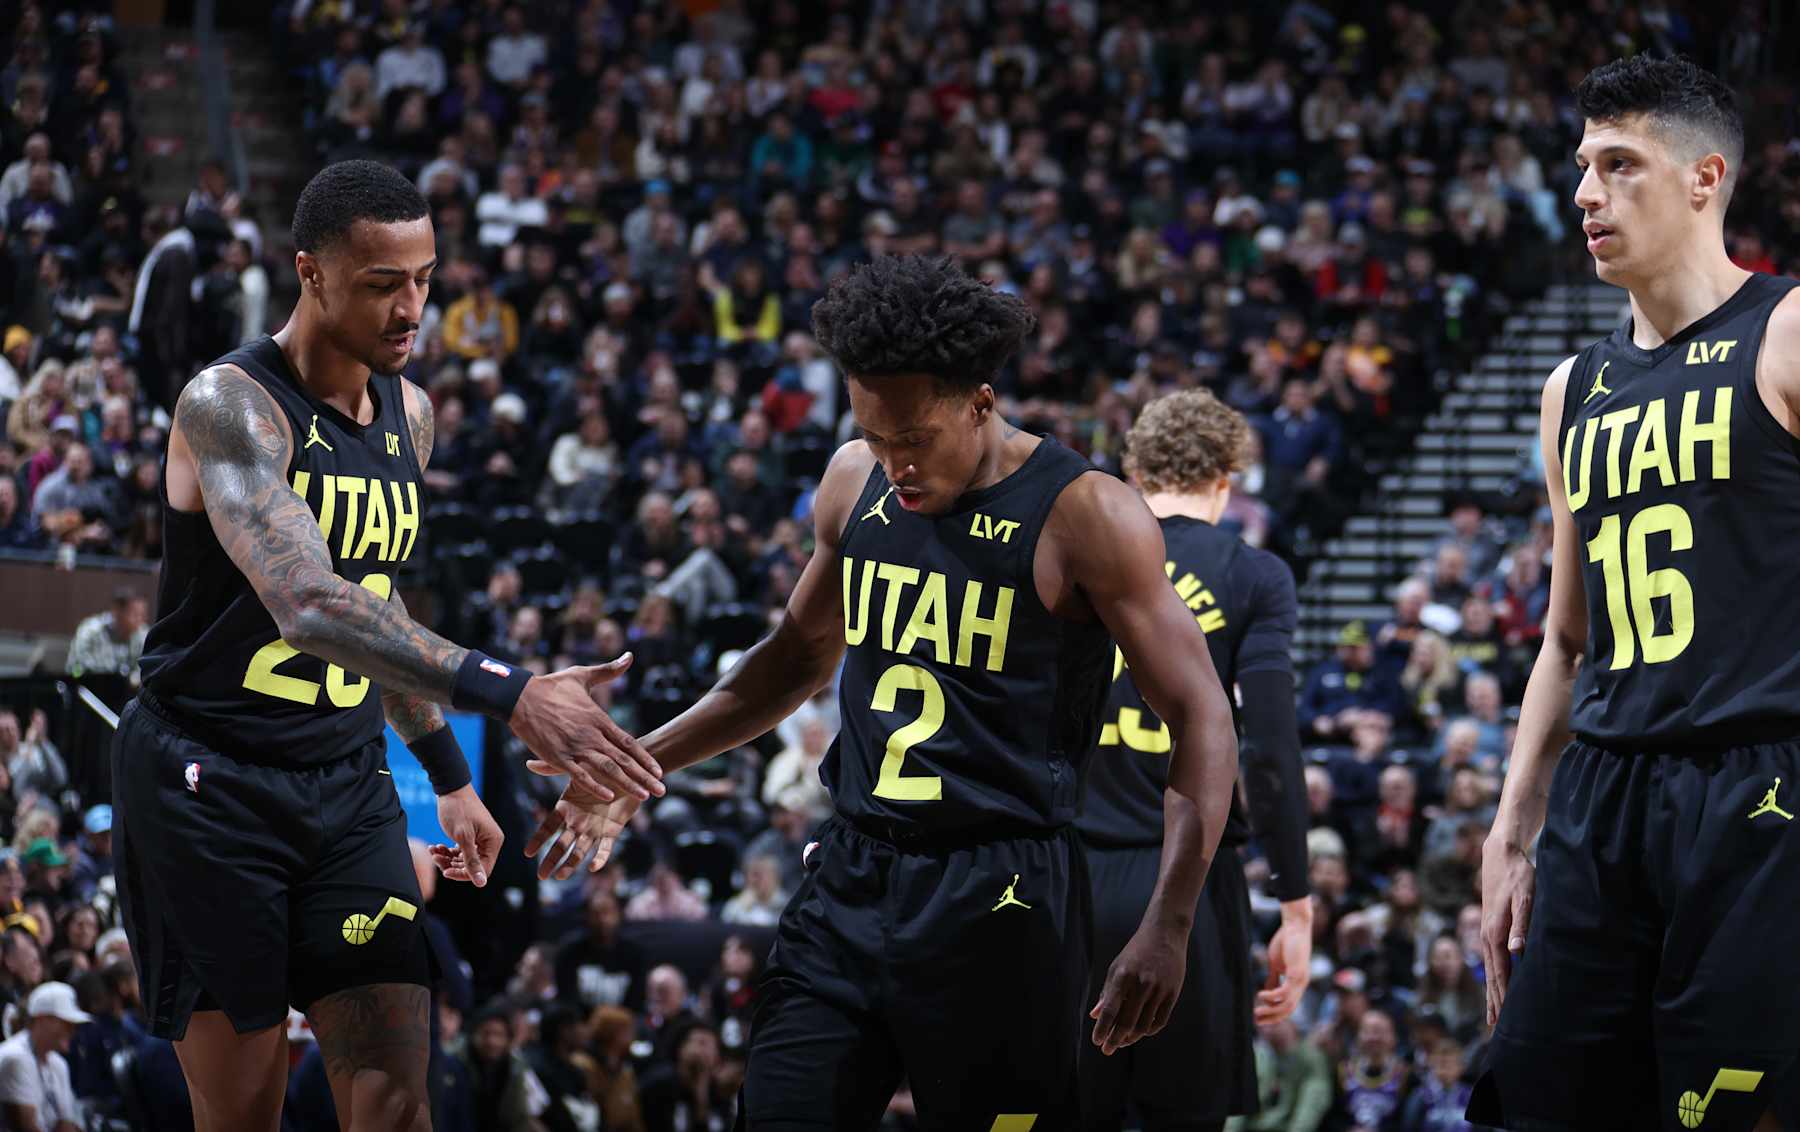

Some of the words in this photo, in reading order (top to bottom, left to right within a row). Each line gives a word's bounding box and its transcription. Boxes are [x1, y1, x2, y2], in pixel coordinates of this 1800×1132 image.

[1687, 340, 1735, 365] LVT
[1564, 386, 1733, 512] UTAH
[292, 471, 419, 561] UTAH
[970, 512, 1020, 543] LVT
[842, 557, 1015, 673] UTAH
[1587, 503, 1694, 670] 16
[871, 663, 945, 801] 2
